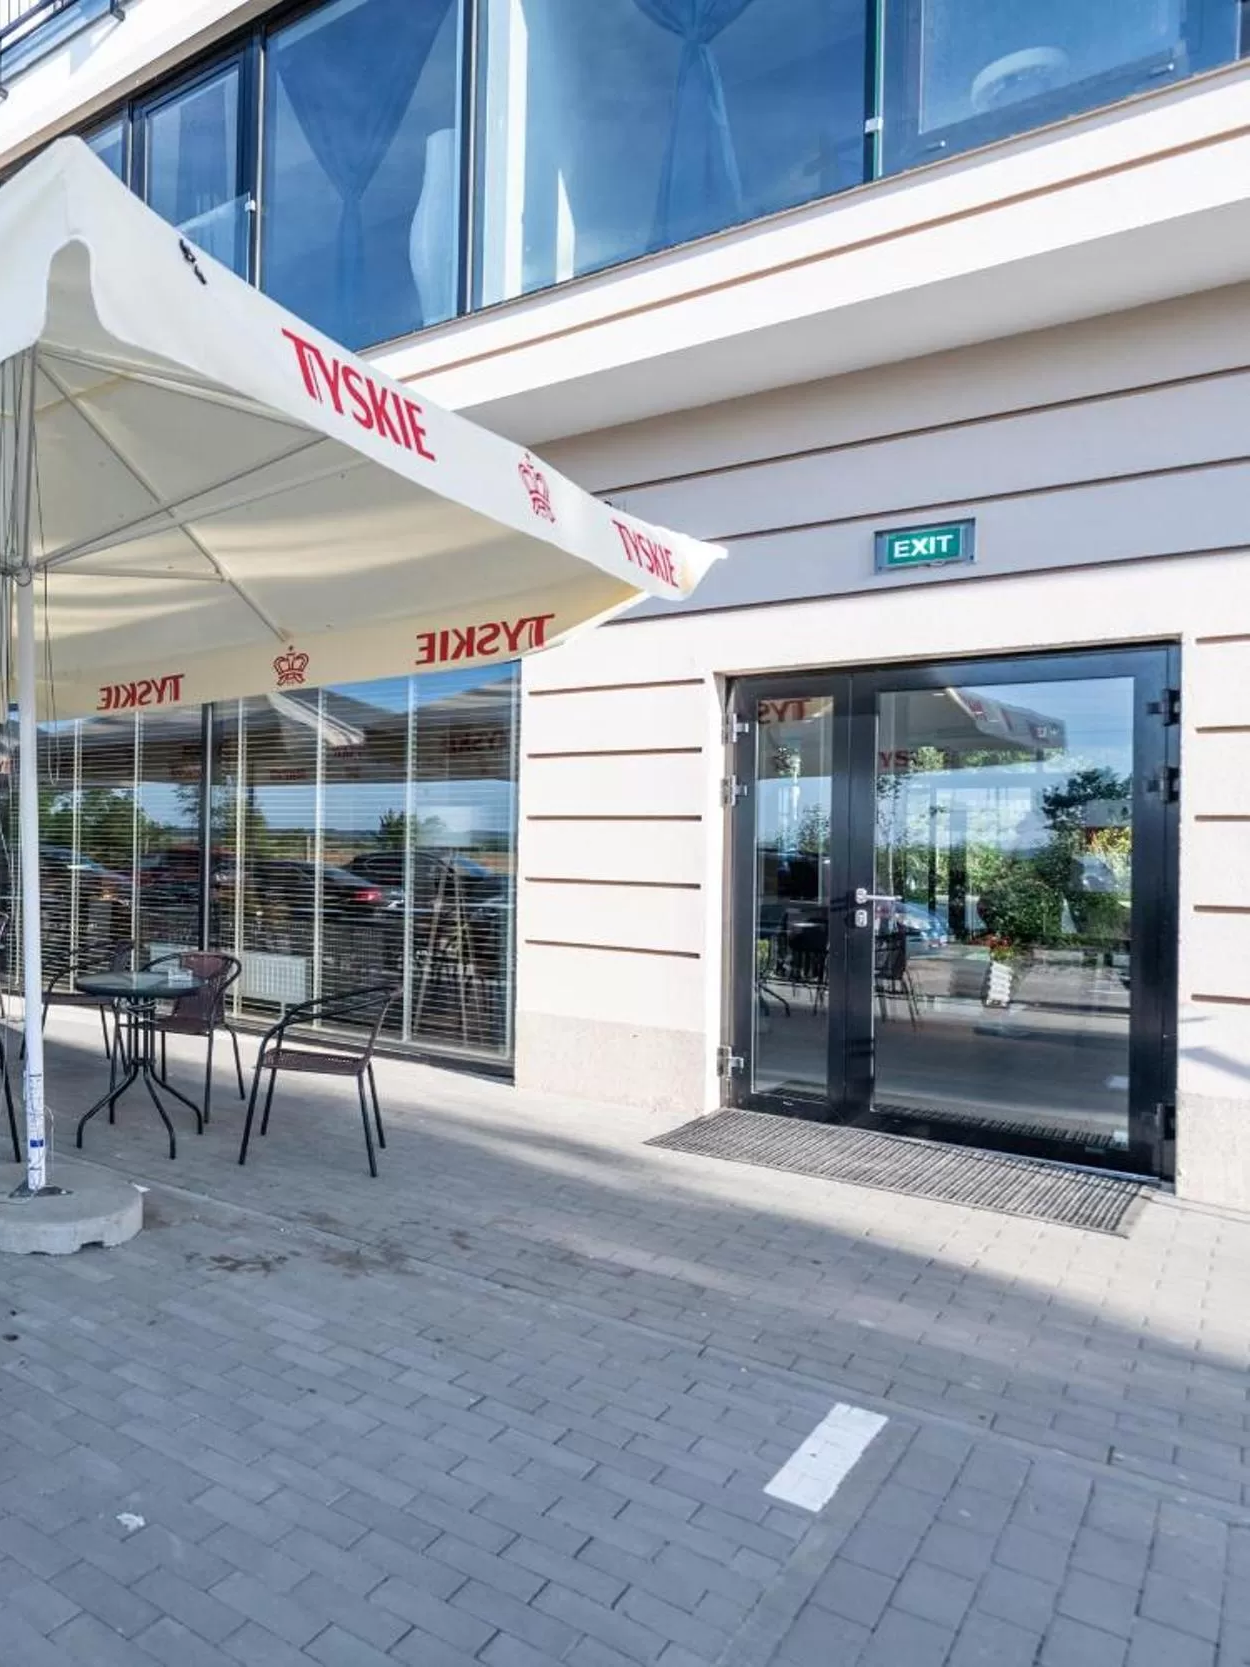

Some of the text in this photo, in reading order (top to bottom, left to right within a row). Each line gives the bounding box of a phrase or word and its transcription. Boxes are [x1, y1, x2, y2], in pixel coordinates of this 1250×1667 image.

[282, 328, 436, 461] TYSKIE
[612, 519, 679, 588] TYSKIE
[893, 535, 954, 558] EXIT
